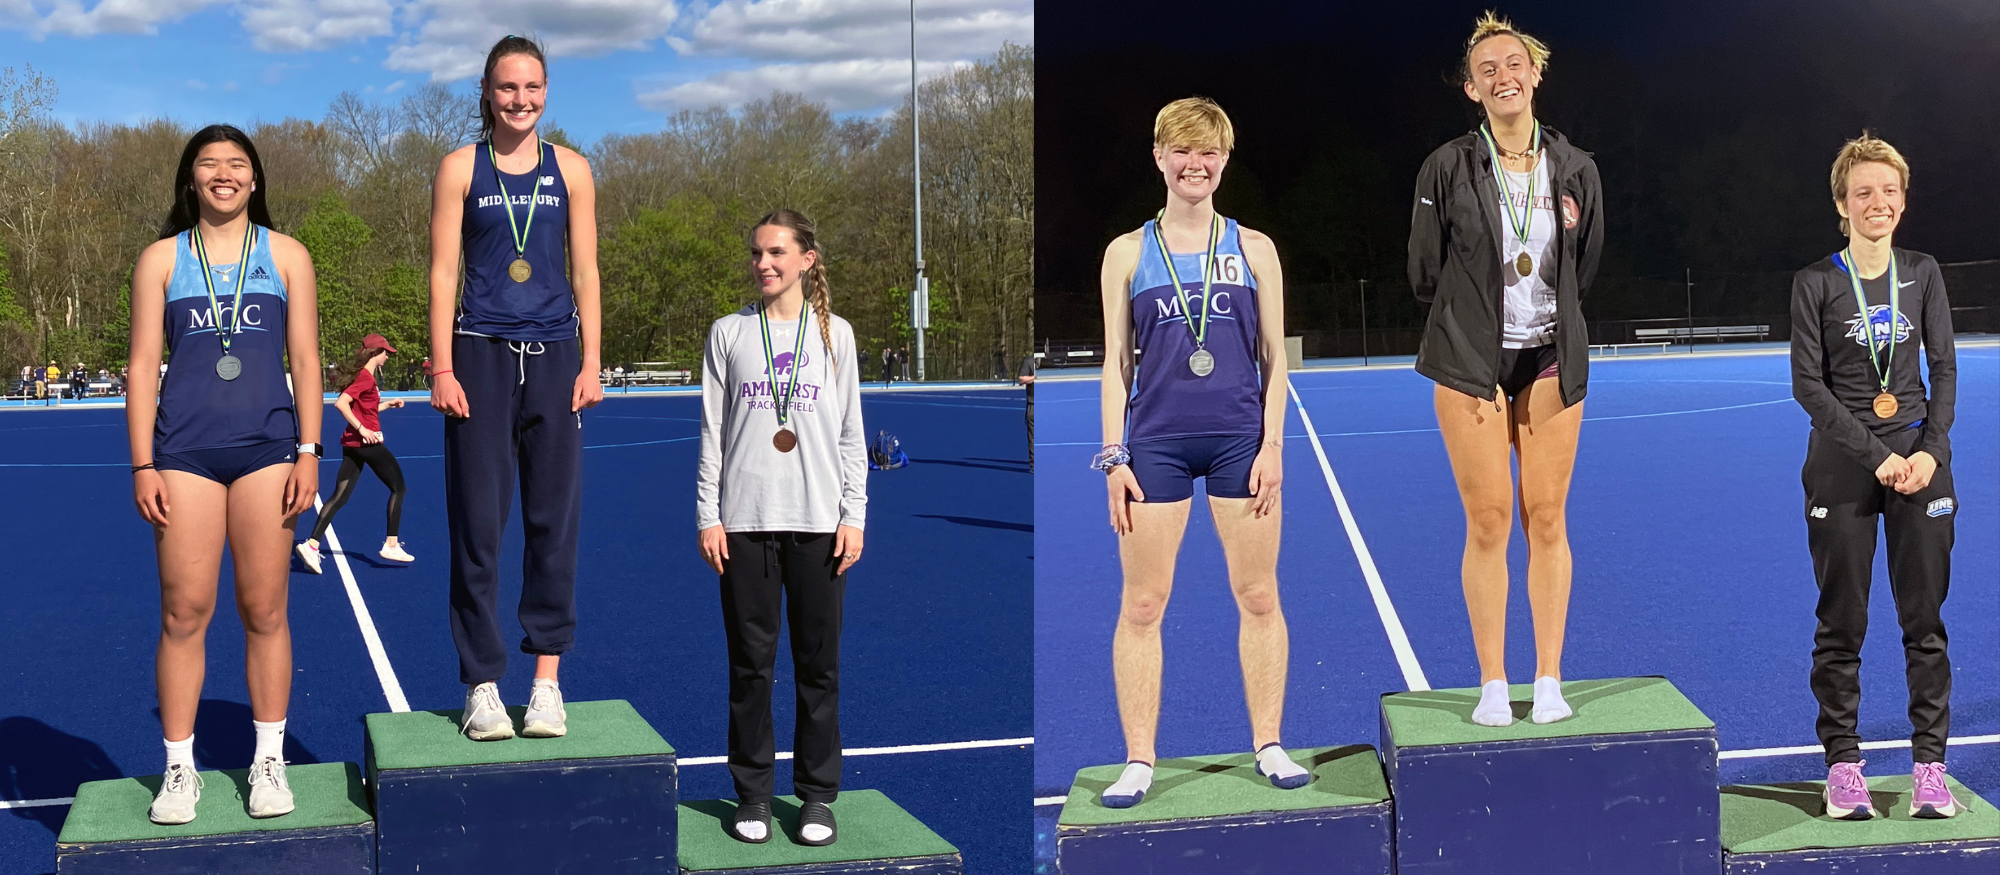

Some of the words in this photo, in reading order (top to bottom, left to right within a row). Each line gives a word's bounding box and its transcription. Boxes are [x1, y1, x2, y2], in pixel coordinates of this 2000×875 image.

[478, 194, 560, 208] MIDLEURY
[248, 272, 270, 280] adidas
[746, 400, 777, 411] TRACK
[788, 401, 815, 413] FIELD
[1928, 499, 1953, 514] UNE
